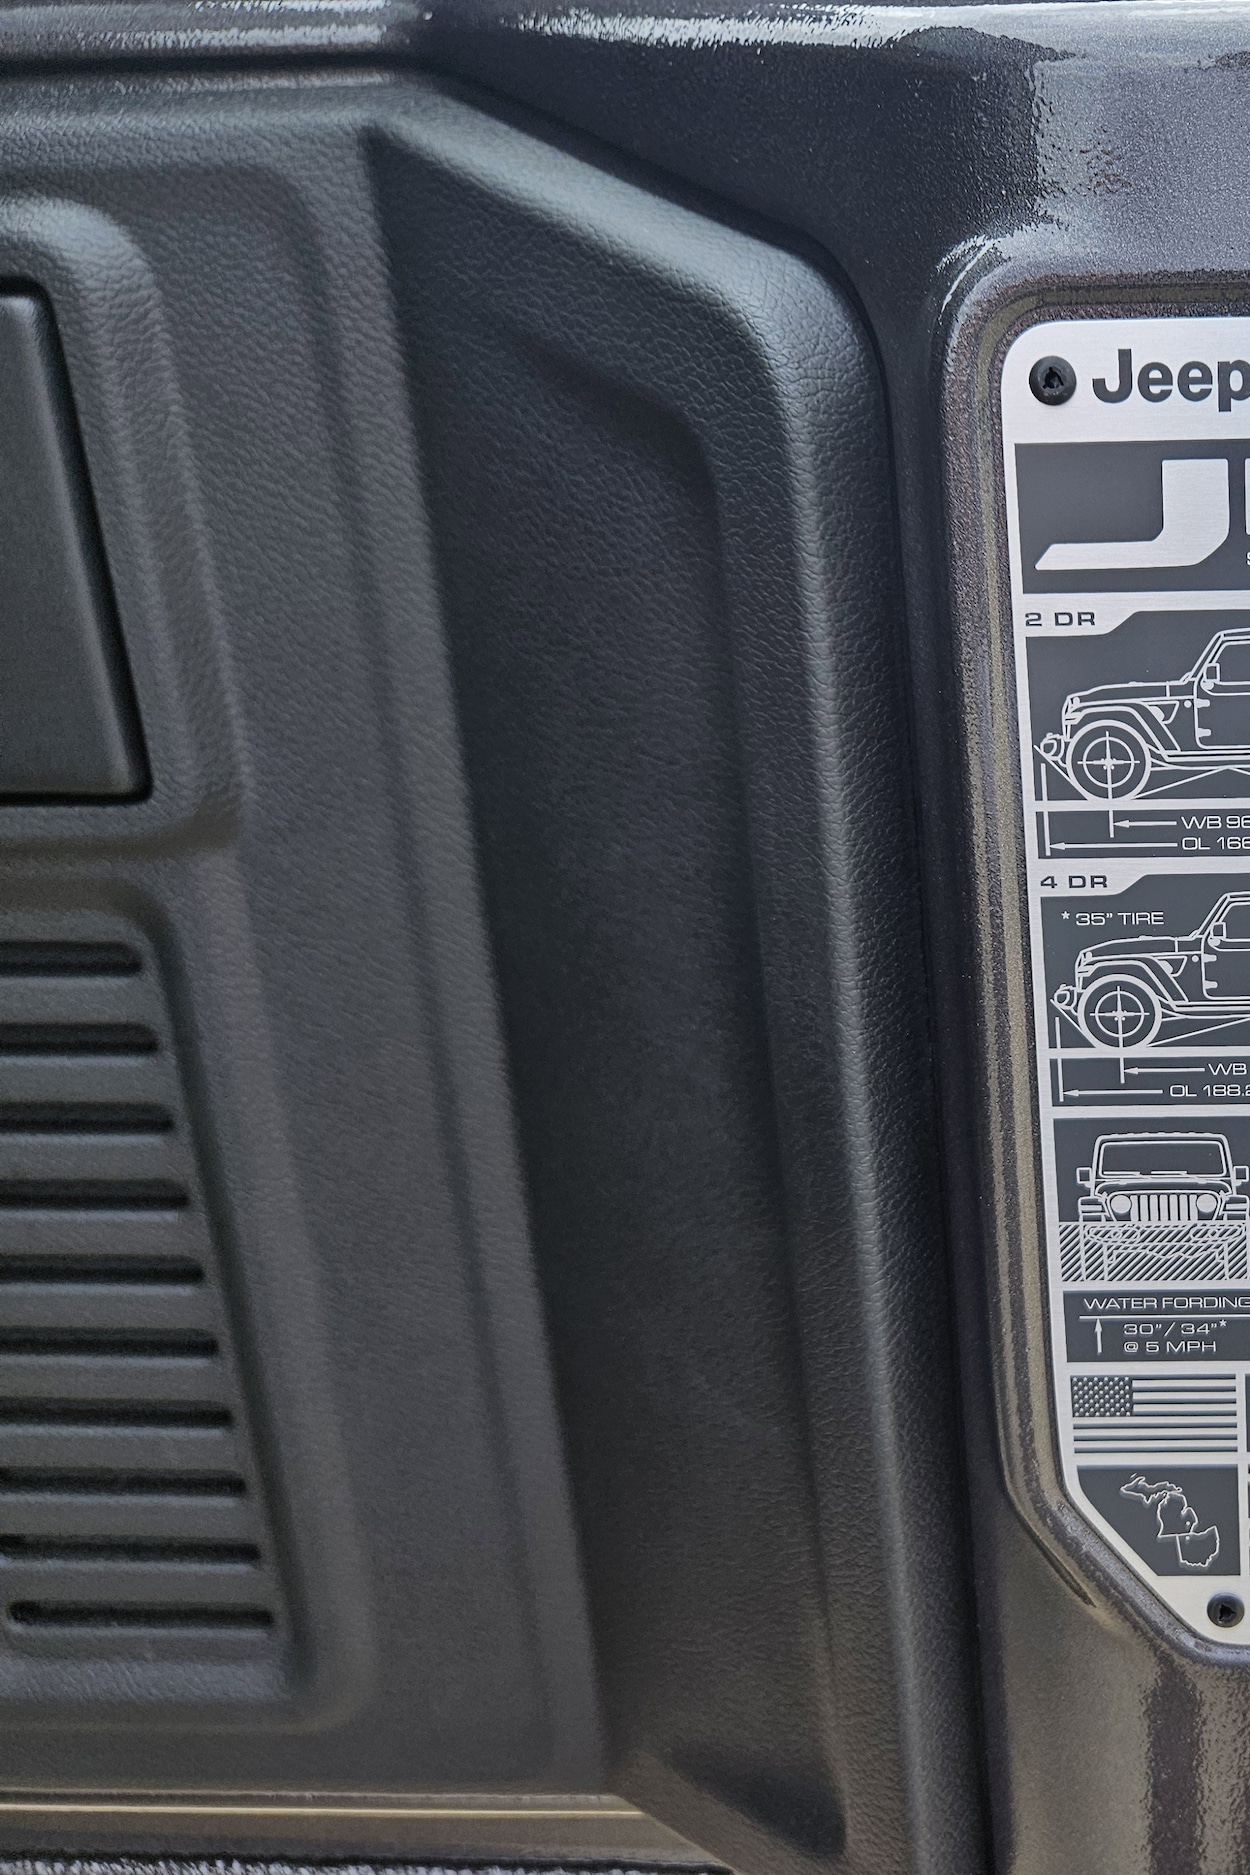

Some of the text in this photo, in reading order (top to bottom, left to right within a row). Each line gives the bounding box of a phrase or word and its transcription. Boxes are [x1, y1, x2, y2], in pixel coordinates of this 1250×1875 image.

[1024, 611, 1097, 627] 2 DR
[1180, 815, 1222, 830] WB
[1181, 836, 1211, 851] OL
[1040, 874, 1108, 889] 4 DR
[1116, 911, 1165, 926] TIRE
[1207, 1062, 1248, 1076] WB
[1169, 1084, 1198, 1098] OL
[1083, 1297, 1158, 1310] WATER
[1122, 1340, 1217, 1354] @ 5 MPH
